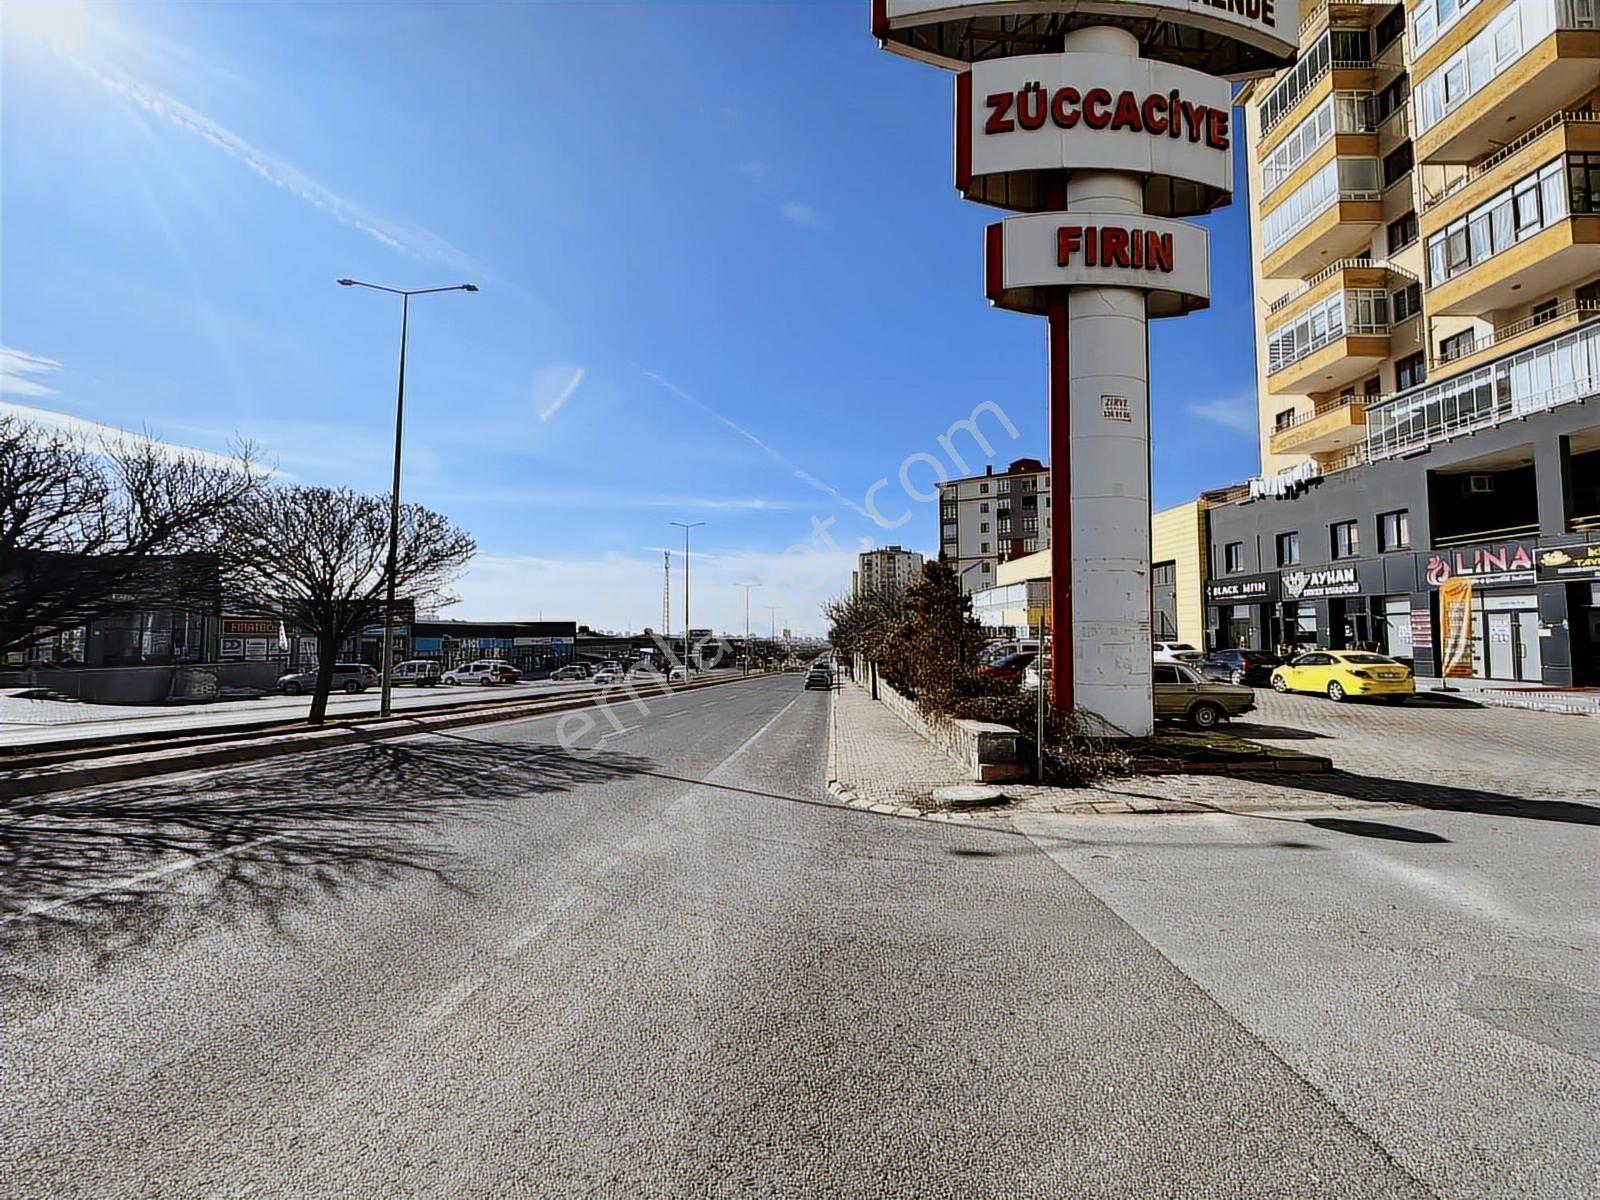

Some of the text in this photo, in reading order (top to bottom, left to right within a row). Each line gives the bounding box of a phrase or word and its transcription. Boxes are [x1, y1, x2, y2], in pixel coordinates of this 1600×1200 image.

[985, 81, 1230, 150] ZÜCCACİYE
[1057, 226, 1174, 273] FIRIN
[1310, 568, 1354, 586] AYHAN
